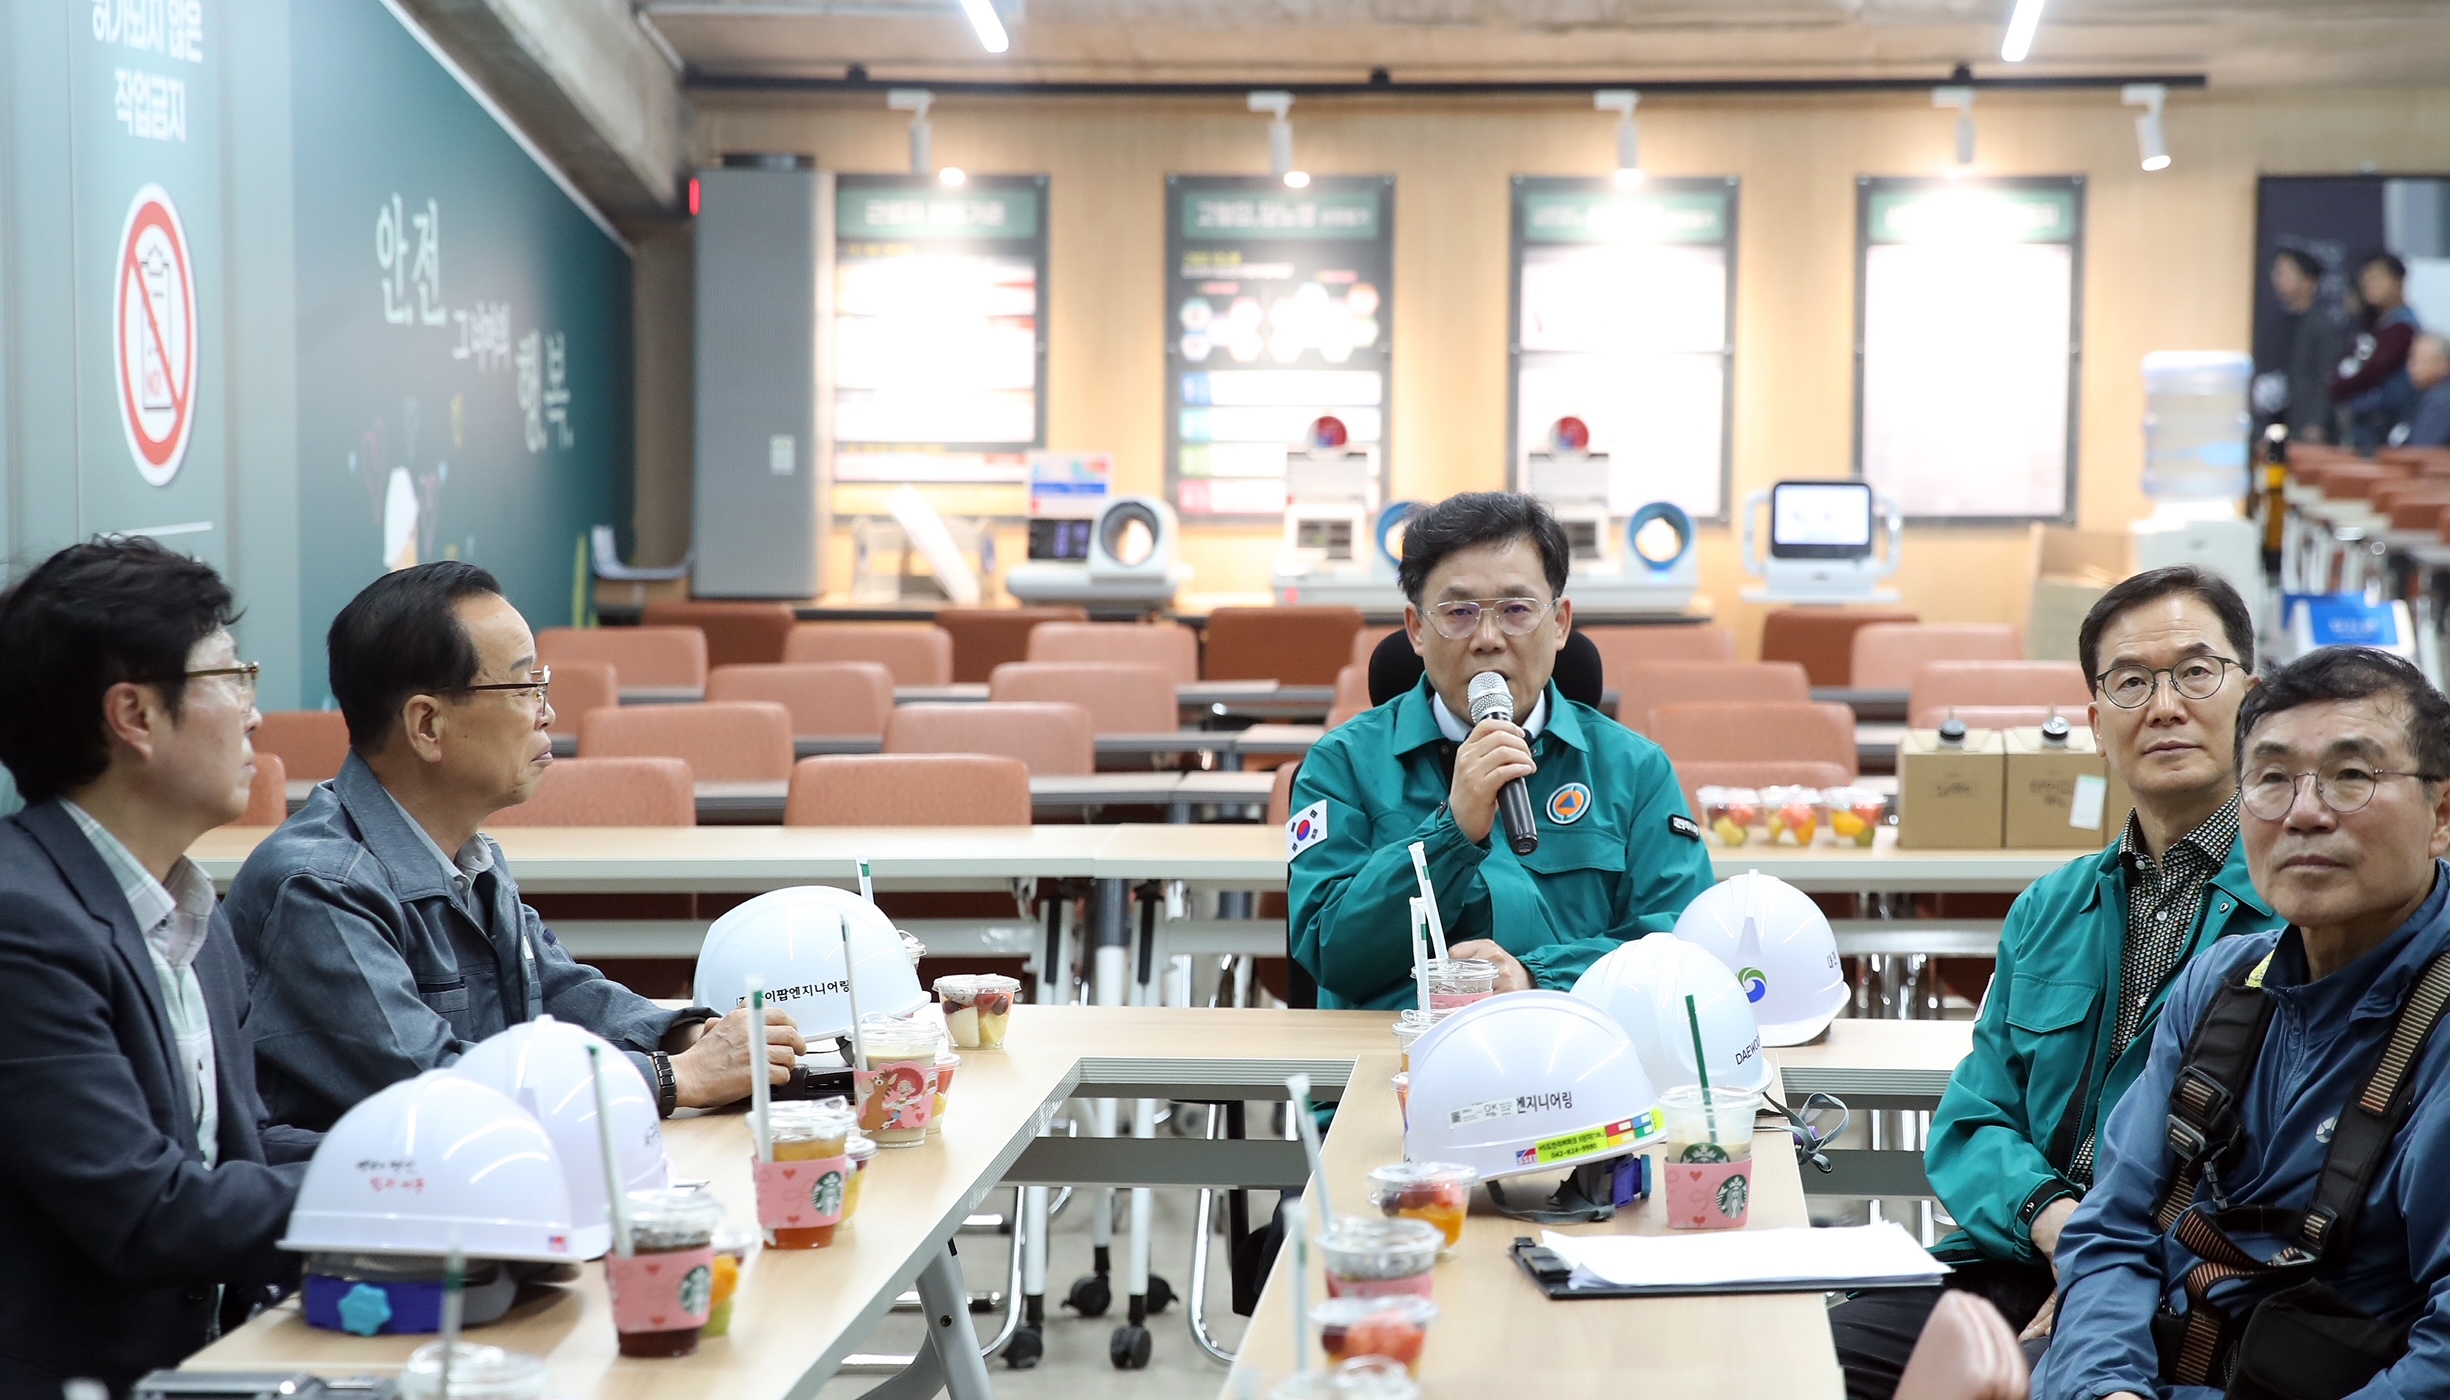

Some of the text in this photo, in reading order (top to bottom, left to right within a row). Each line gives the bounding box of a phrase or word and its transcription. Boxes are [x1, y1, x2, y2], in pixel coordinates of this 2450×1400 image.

[167, 0, 203, 64] 않은
[114, 66, 187, 143] 작업금지
[376, 192, 447, 327] 안전
